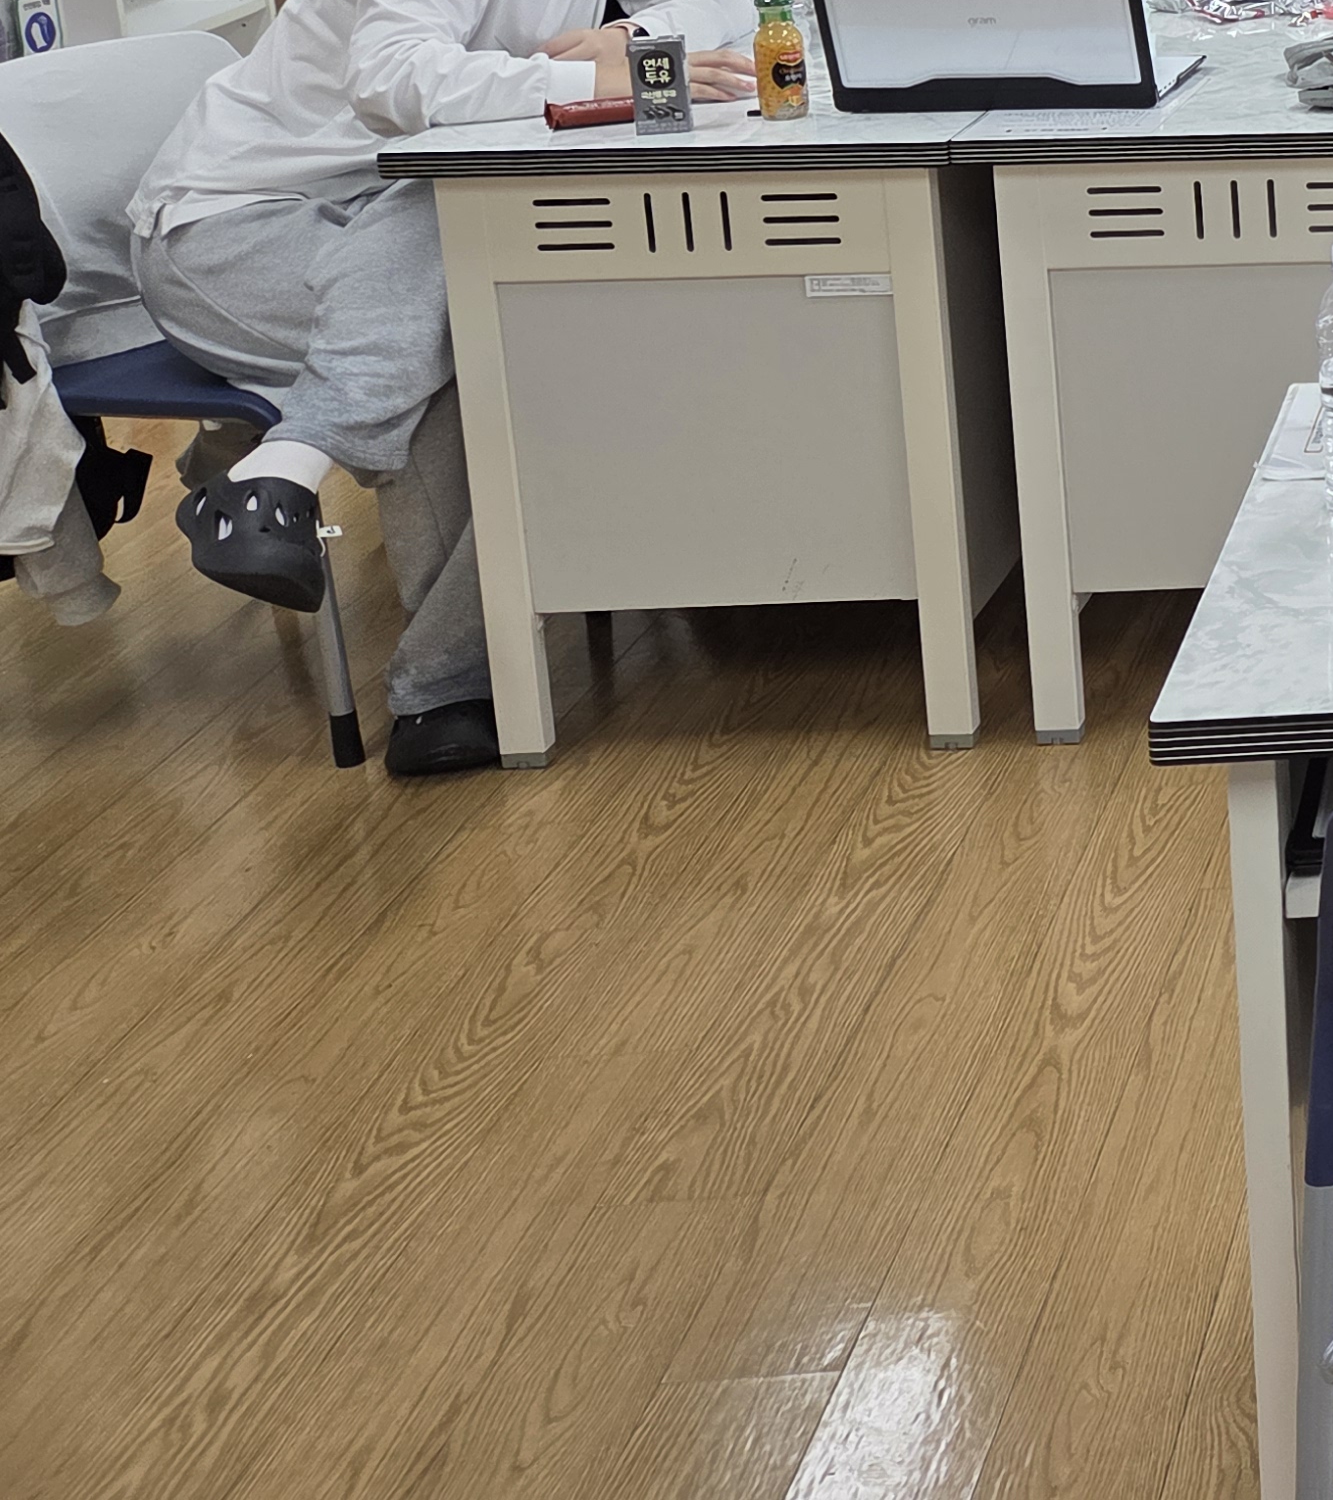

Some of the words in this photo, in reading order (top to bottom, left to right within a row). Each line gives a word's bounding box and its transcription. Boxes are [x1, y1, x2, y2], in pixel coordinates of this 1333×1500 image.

[967, 17, 997, 29] gram
[643, 57, 670, 71] 연세
[645, 70, 672, 85] 두유
